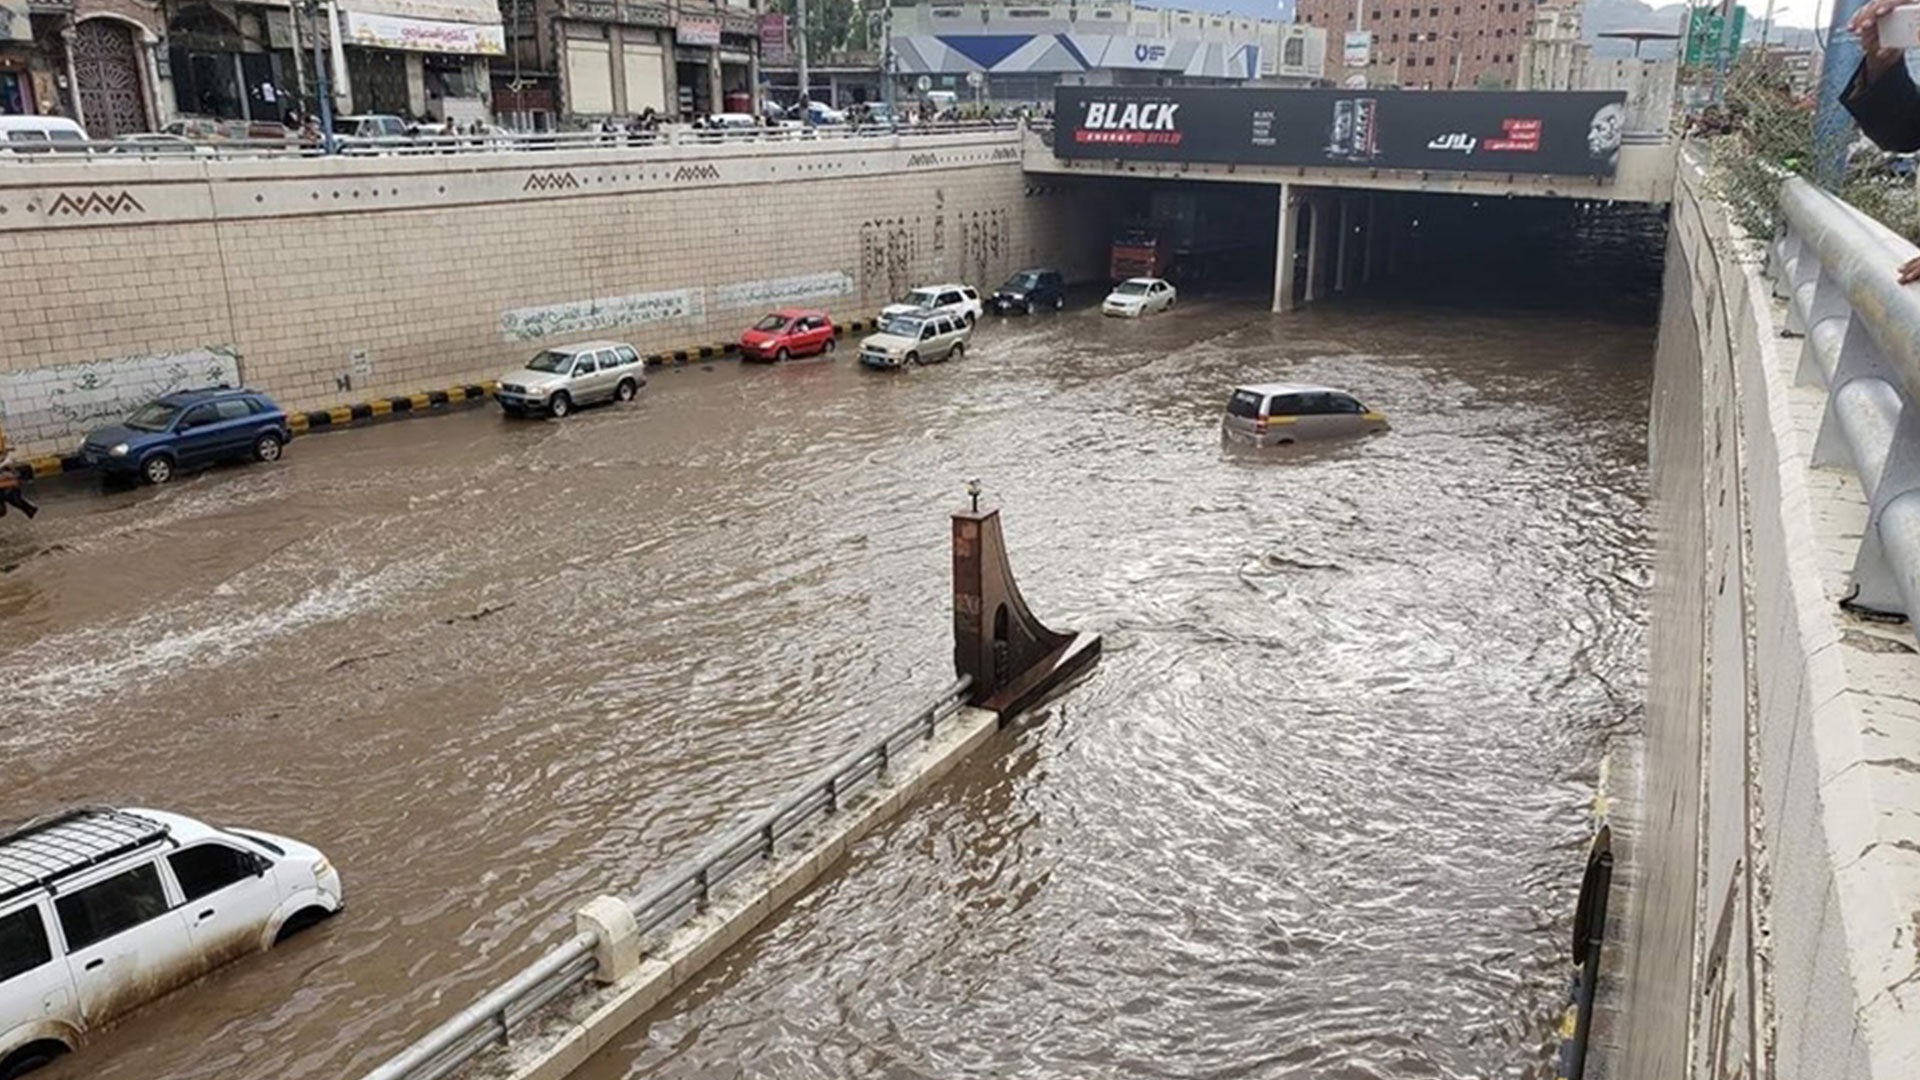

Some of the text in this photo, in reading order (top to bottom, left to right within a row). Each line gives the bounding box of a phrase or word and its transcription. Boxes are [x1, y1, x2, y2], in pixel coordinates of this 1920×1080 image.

[1084, 102, 1179, 130] BLACK
[1086, 133, 1133, 142] ENERGY
[1427, 133, 1477, 154] بلاك
